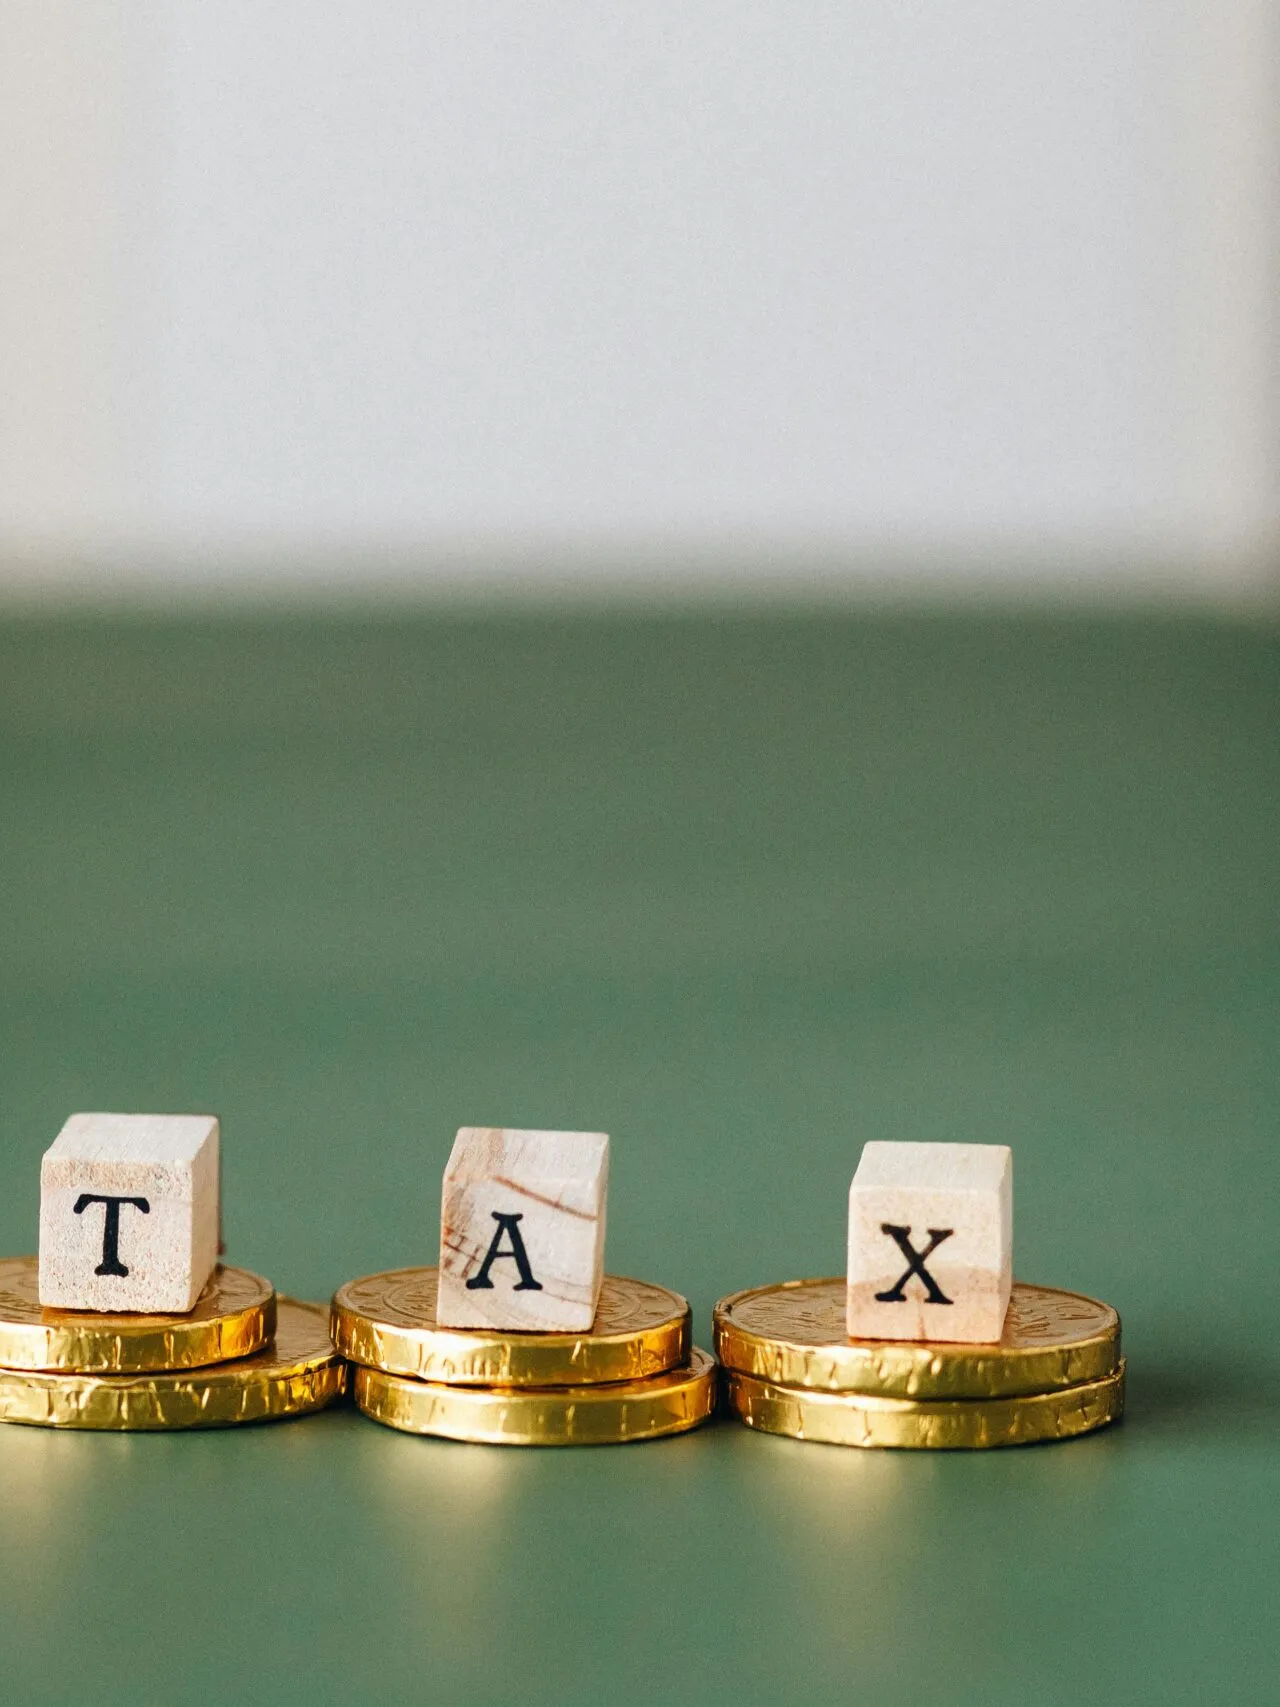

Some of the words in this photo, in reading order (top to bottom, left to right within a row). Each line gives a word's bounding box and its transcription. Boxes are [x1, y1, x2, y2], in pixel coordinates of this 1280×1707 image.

[73, 1193, 150, 1278] T
[465, 1211, 543, 1291] A
[874, 1223, 954, 1305] X
